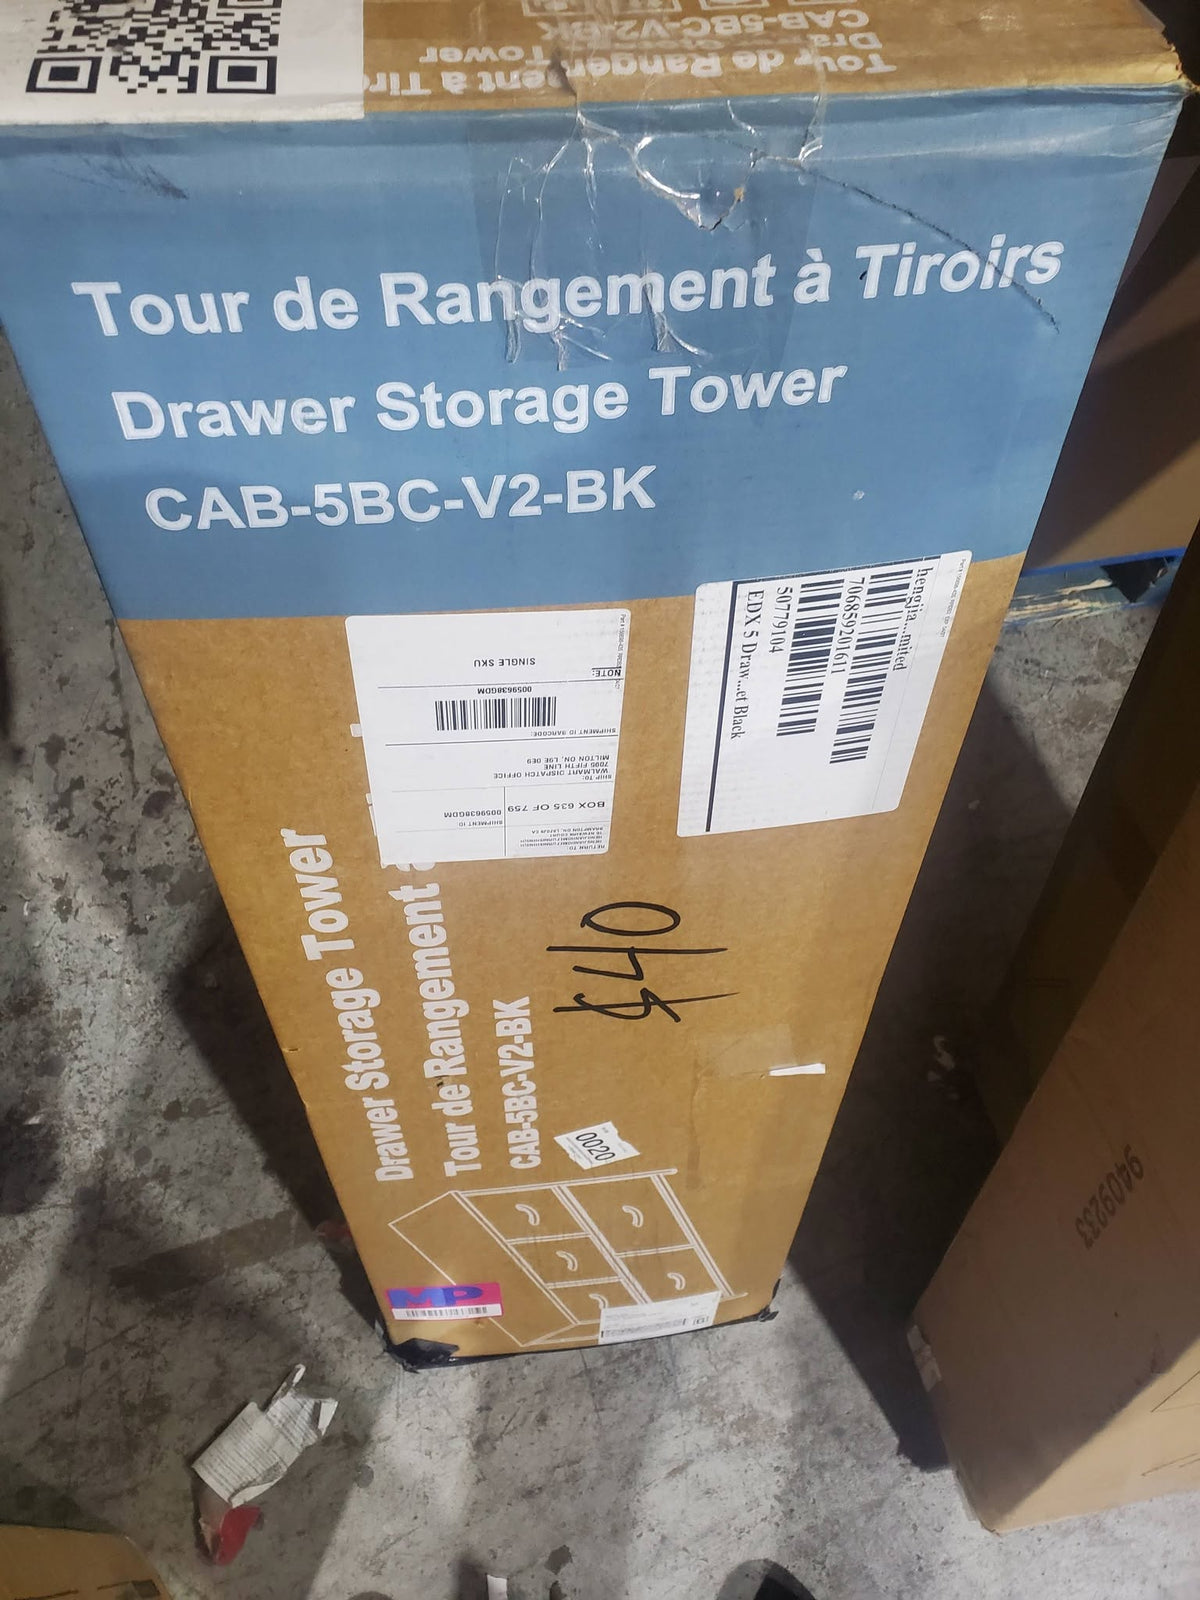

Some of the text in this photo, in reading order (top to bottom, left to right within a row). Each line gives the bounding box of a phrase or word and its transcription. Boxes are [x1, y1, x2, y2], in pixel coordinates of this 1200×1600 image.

[419, 45, 551, 65] Tower
[732, 49, 784, 74] de
[794, 48, 897, 74] Tour
[71, 234, 1064, 337] Tour de Rangement à Tiroirs
[111, 364, 849, 440] Drawer Storage Tower
[145, 465, 656, 531] CAB-5BC-V2-BK
[744, 589, 764, 627] EDX
[769, 586, 793, 654] 50779104
[830, 577, 866, 675] 706859201611
[743, 630, 757, 638] 5
[473, 657, 536, 667] SINGLE SKU
[592, 669, 621, 677] NOTE:
[730, 706, 750, 740] Black
[524, 769, 566, 778] DISPATCH
[567, 768, 609, 776] WALMART
[507, 801, 605, 812] BOX 635 OF 759
[387, 882, 469, 1078] Rangement
[546, 901, 740, 1022] $40
[280, 828, 414, 1182] Drawer Storage Tower
[493, 996, 541, 1170] CAB-5BC-V2-BK
[432, 1082, 473, 1125] de
[444, 1122, 482, 1176] Tour
[576, 1132, 615, 1161] 0020
[1075, 1143, 1144, 1250] 9409233
